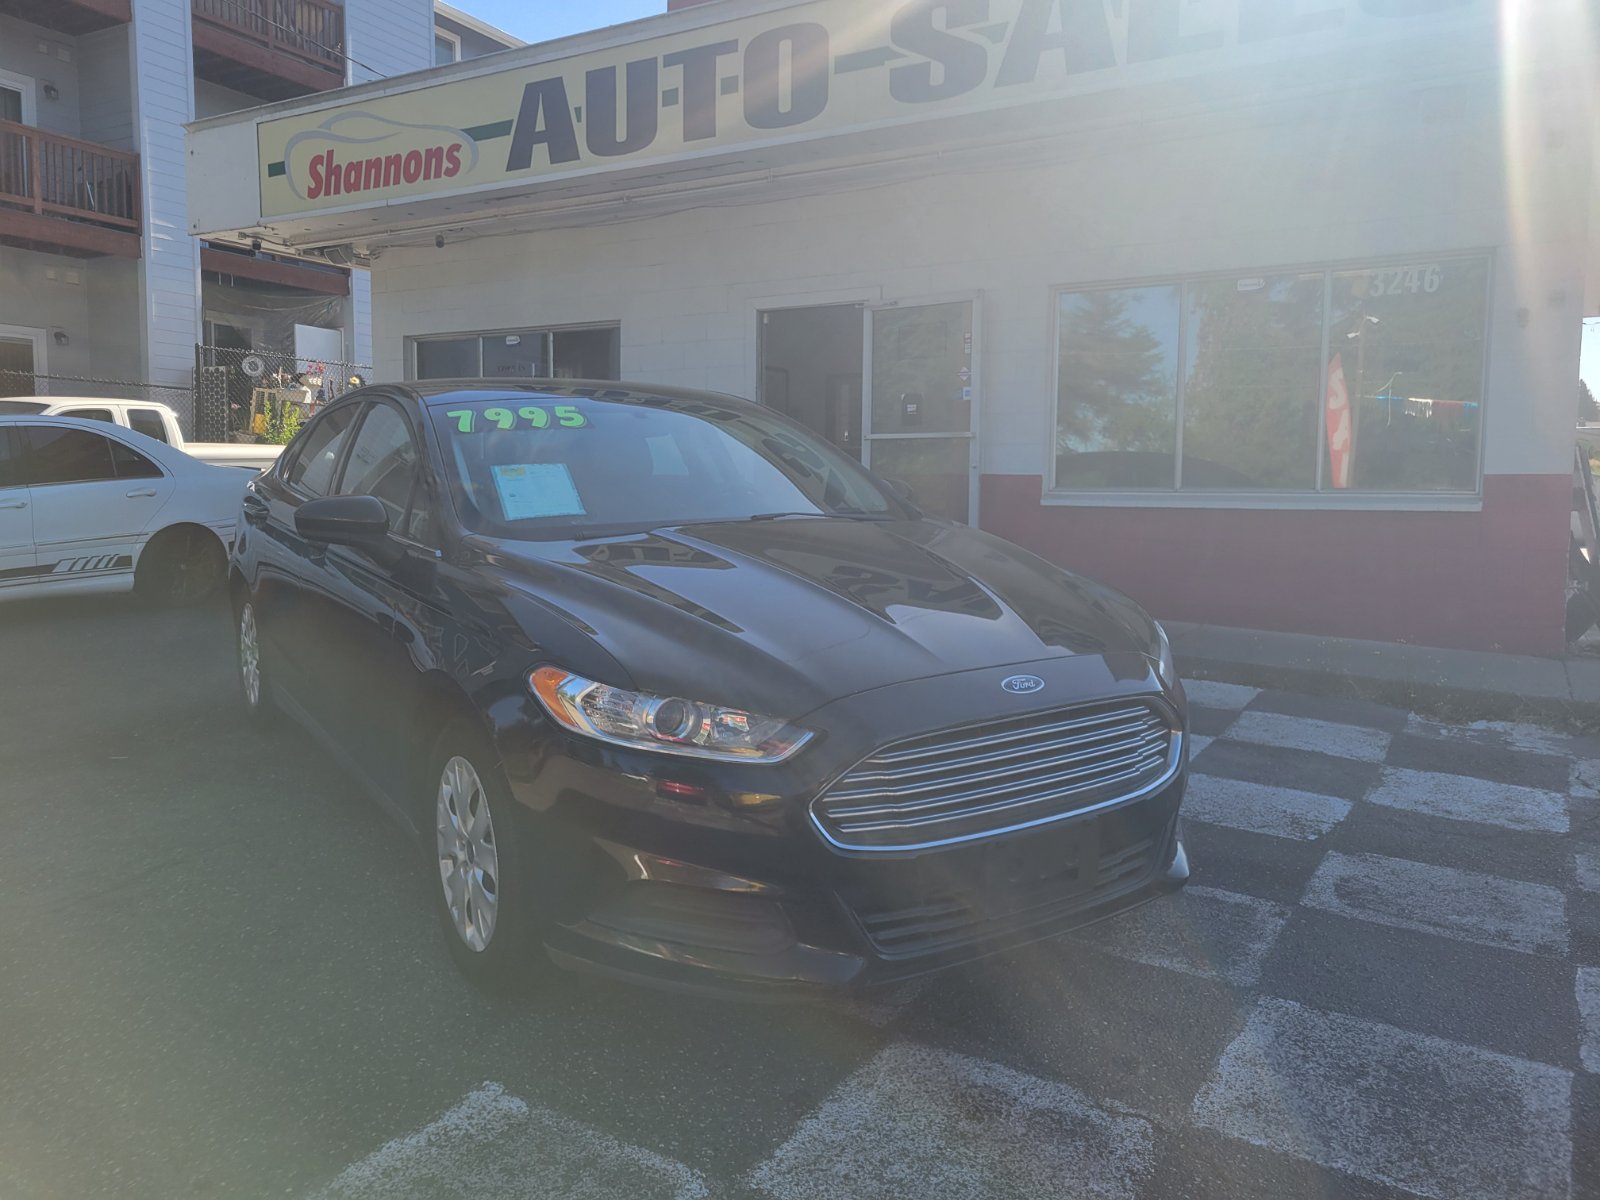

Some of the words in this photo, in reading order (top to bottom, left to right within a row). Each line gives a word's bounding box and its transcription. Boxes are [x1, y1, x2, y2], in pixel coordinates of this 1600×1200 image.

[307, 143, 462, 199] Shannons
[506, 22, 829, 172] AUTO
[889, 0, 1473, 104] SAL
[1369, 265, 1441, 297] 3246
[447, 406, 588, 433] 7995
